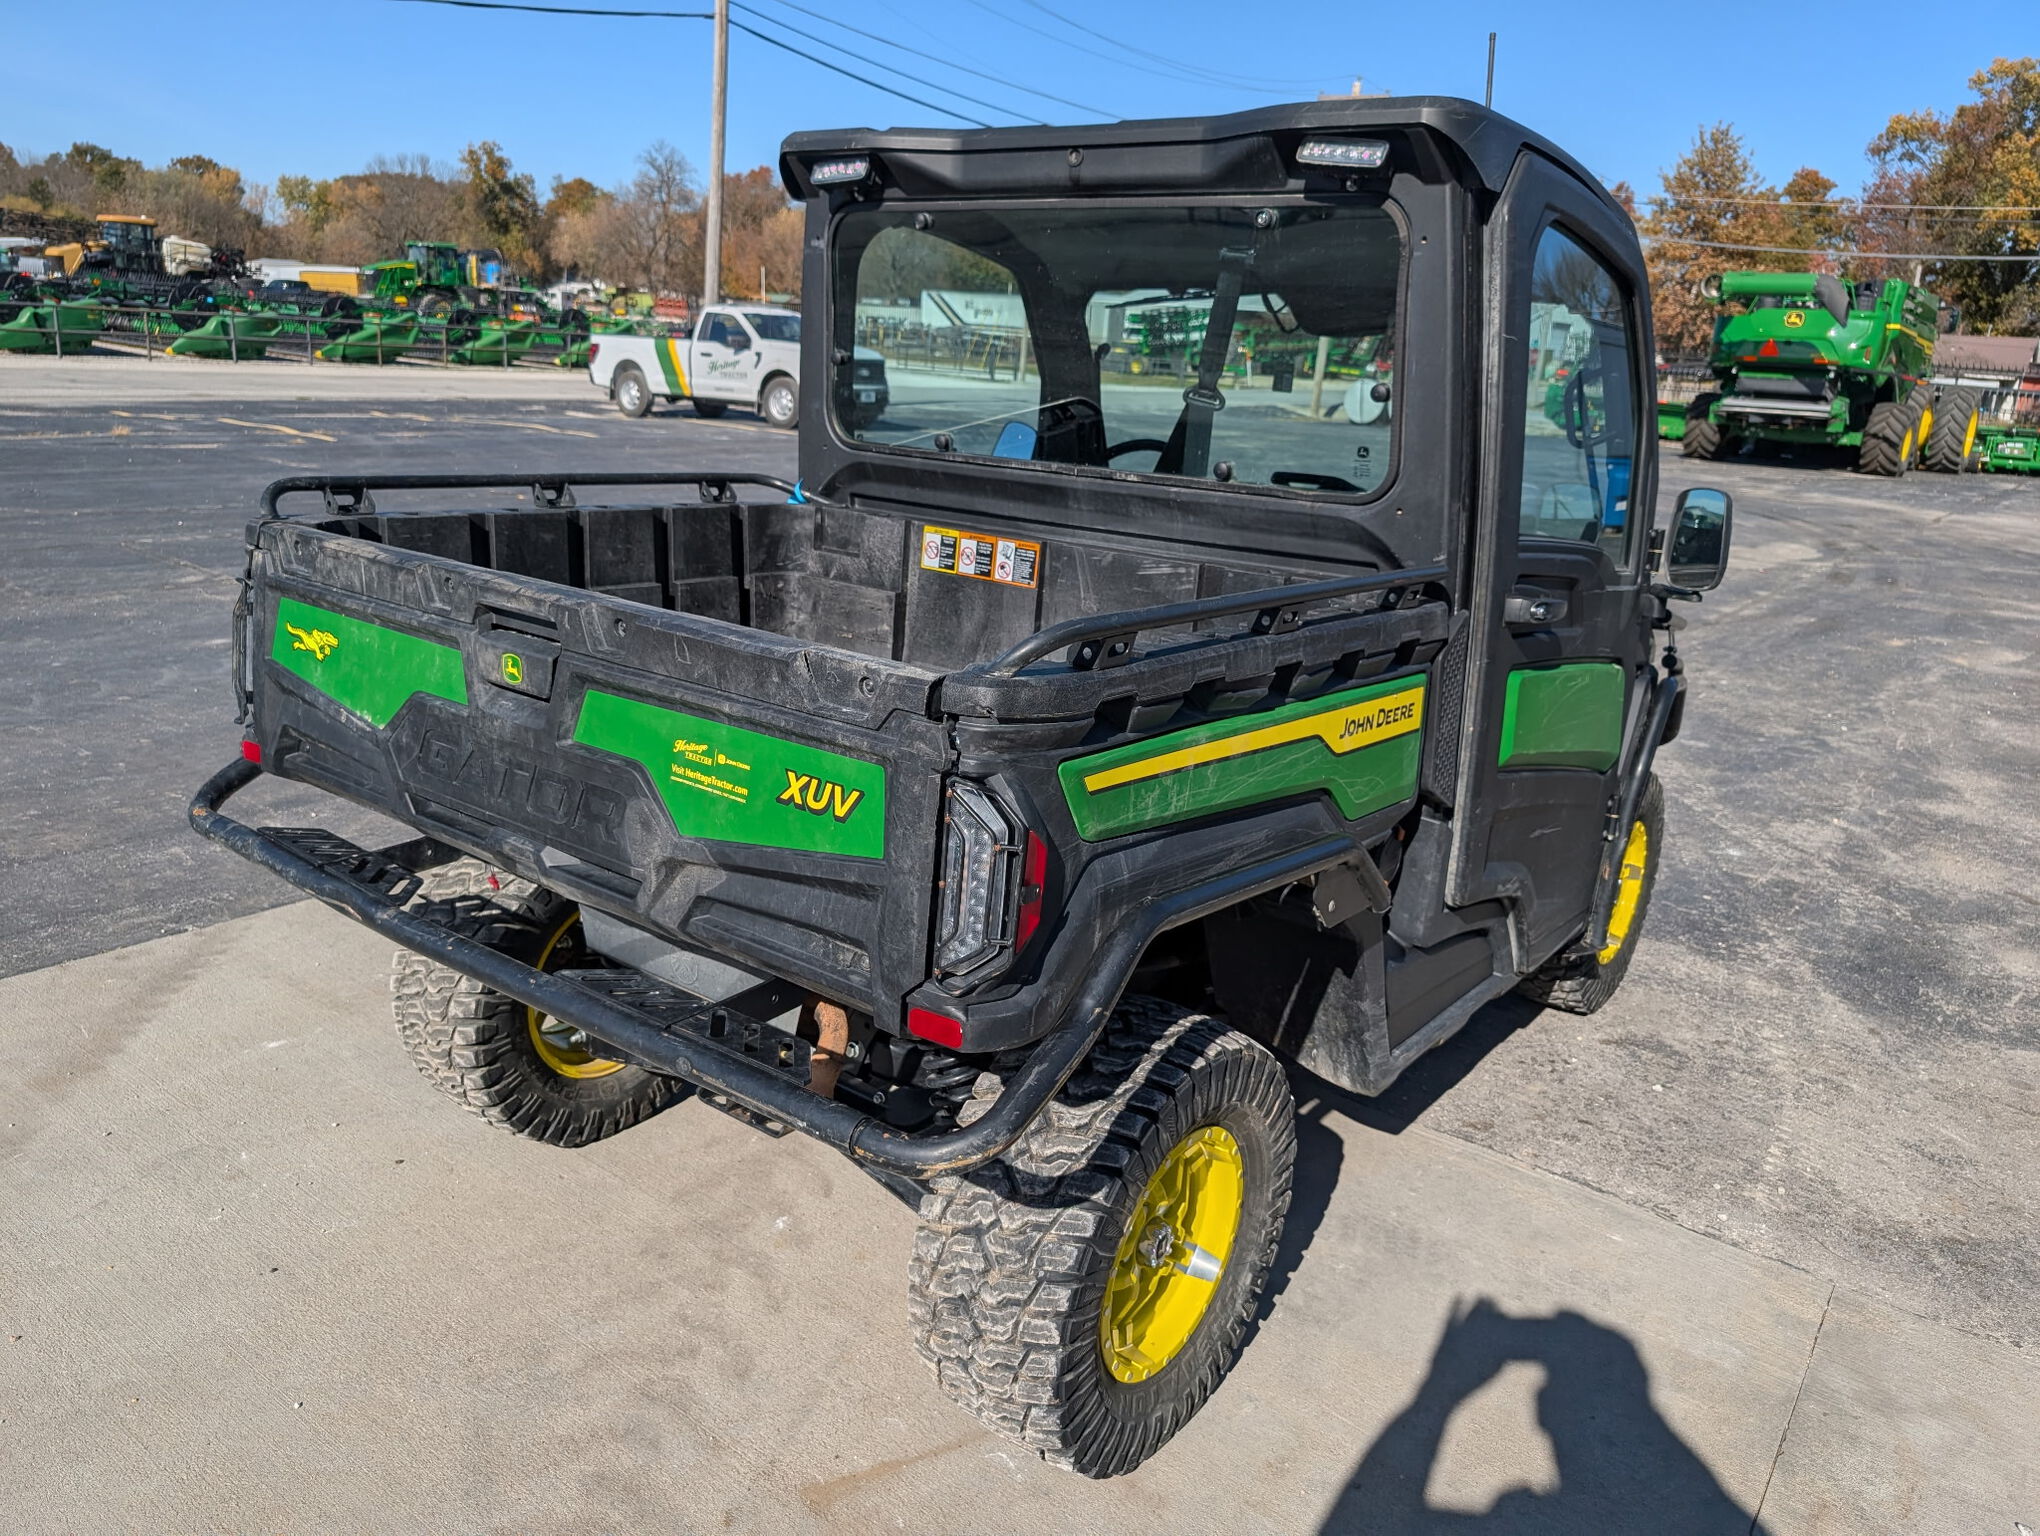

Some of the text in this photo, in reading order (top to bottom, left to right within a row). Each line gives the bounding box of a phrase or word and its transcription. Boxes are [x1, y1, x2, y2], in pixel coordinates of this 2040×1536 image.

[1339, 702, 1415, 739] JOHN DEERE
[673, 739, 708, 753] Heritage
[417, 728, 626, 845] GATOR
[671, 763, 685, 776] Visit
[685, 767, 749, 796] HeritageTractor.com
[776, 768, 865, 824] XUV
